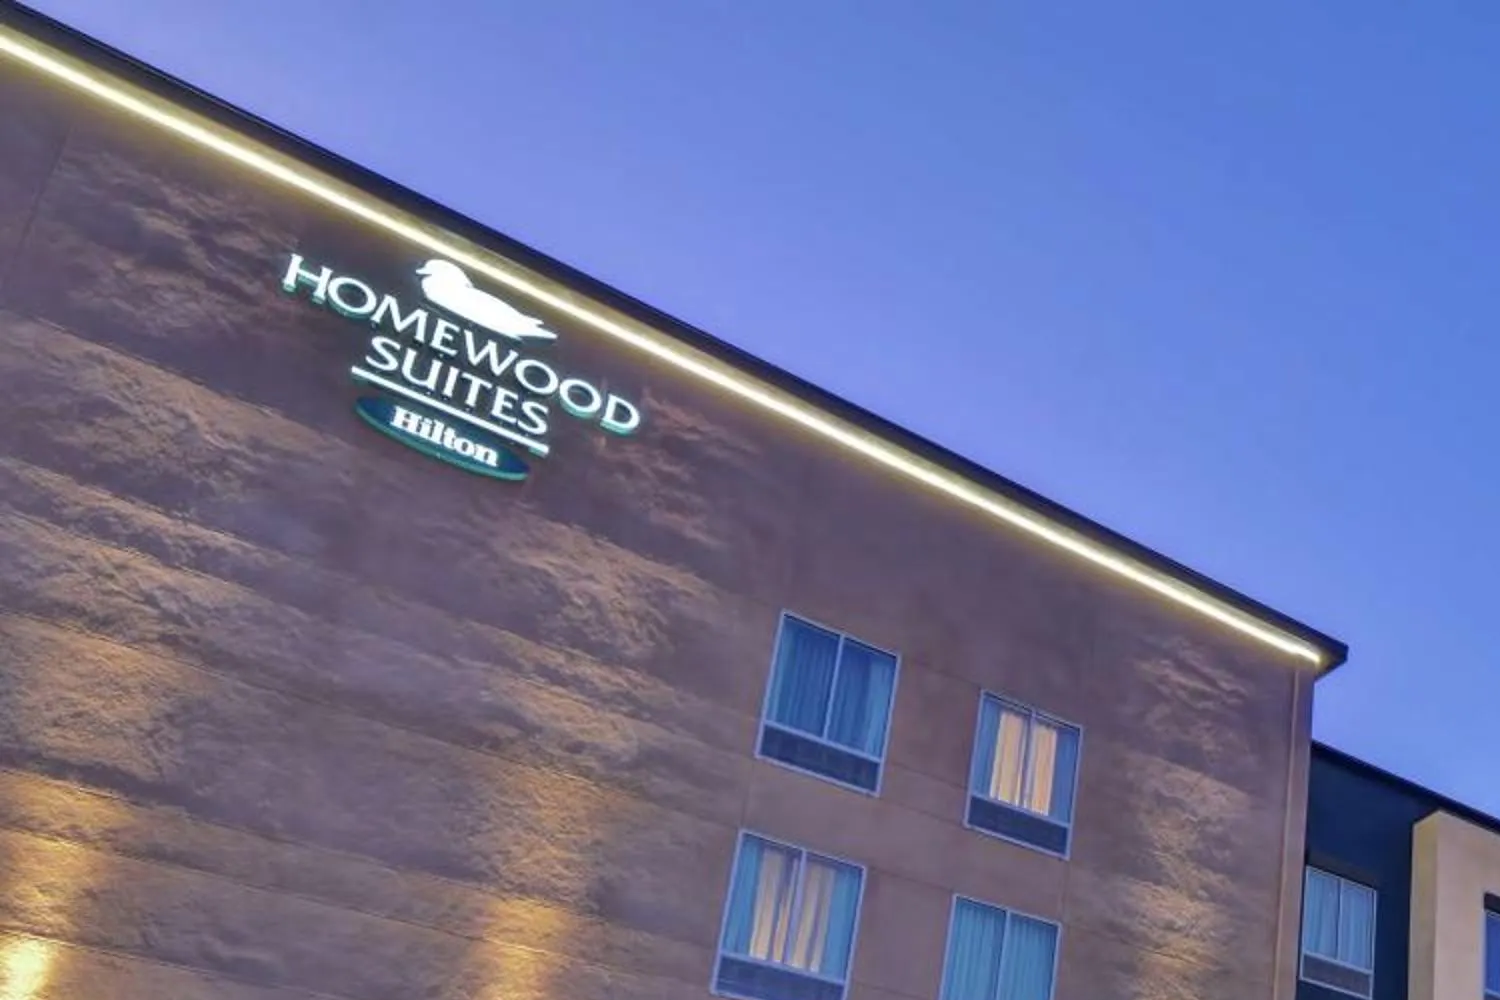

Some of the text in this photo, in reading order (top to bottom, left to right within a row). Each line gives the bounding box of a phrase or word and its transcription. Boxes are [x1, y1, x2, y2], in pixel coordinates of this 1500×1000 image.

[282, 254, 641, 433] HOMEWOOD
[365, 335, 549, 435] SUITES
[389, 406, 499, 468] Hilton
